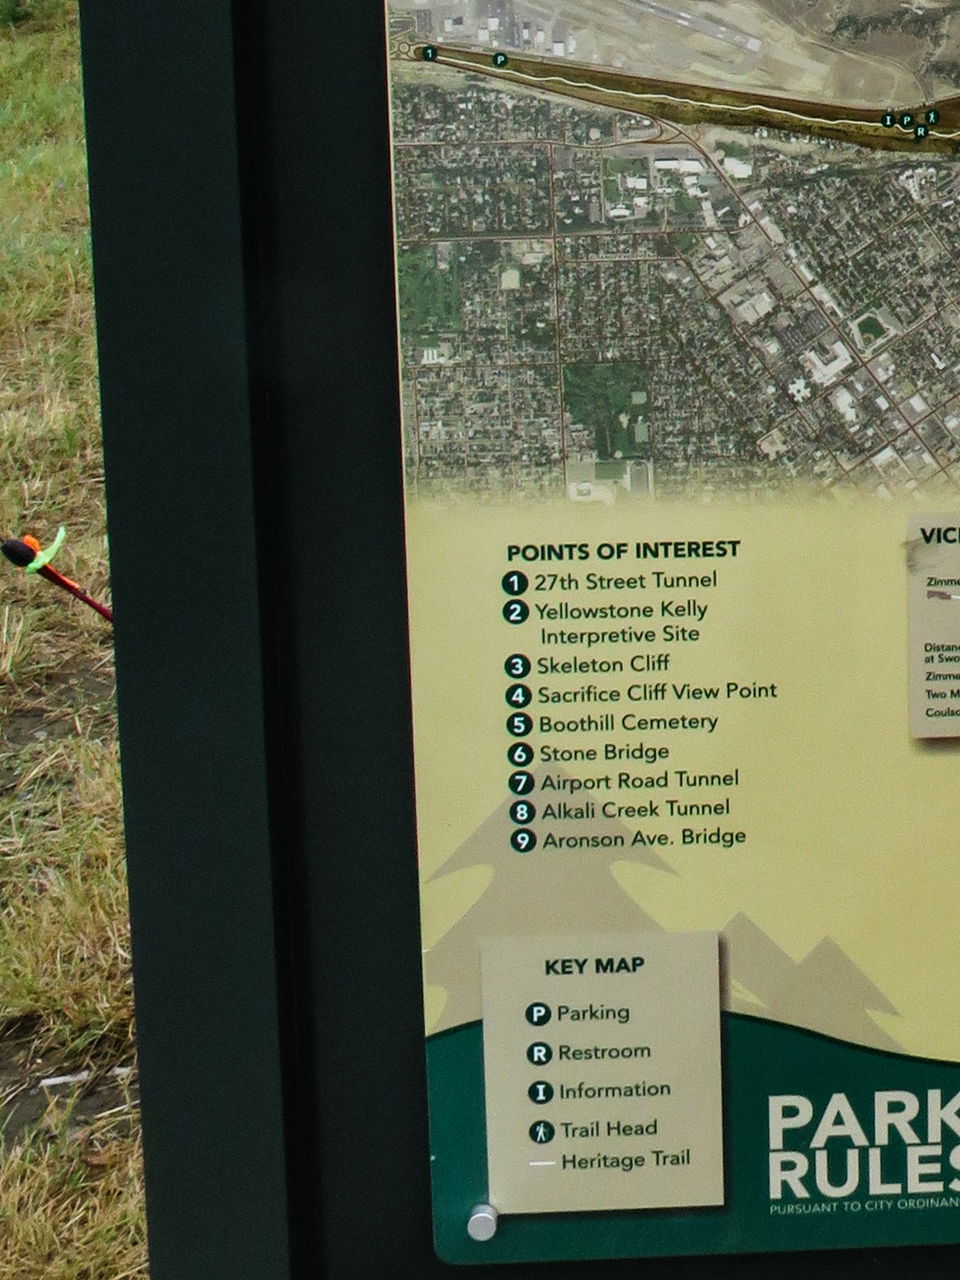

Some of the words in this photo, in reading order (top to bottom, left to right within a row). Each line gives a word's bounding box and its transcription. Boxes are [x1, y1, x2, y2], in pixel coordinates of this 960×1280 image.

[508, 544, 589, 561] POINTS
[597, 543, 628, 559] OF
[636, 541, 740, 558] INTEREST
[535, 574, 579, 591] 27th
[586, 573, 646, 590] Street
[652, 571, 717, 587] Tunnel
[536, 603, 653, 620] Yellowstone
[661, 600, 708, 621] Kelly
[542, 628, 656, 648] Interpretive
[663, 626, 699, 642] Site
[538, 657, 623, 674] Skeleton
[631, 654, 670, 671] Cliff
[538, 686, 620, 703] Sacrifice
[628, 684, 668, 701] Cliff
[672, 683, 719, 699] View
[727, 682, 777, 699] Point
[925, 690, 946, 699] Two
[540, 715, 614, 733] Boothill
[622, 715, 718, 733] Cemetery
[541, 745, 597, 762] Stone
[605, 743, 669, 763] Bridge
[541, 775, 611, 794] Airport
[619, 772, 668, 788] Road
[675, 769, 738, 787] Tunnel
[542, 803, 594, 819] Alkali
[602, 800, 659, 817] Creek
[666, 799, 730, 815] Tunnel
[543, 832, 624, 849] Aronson
[632, 831, 673, 846] Ave.
[682, 828, 746, 847] Bridge
[546, 959, 588, 975] KEY
[596, 957, 644, 973] MAP
[558, 1005, 630, 1022] Parking
[559, 1044, 651, 1060] Restroom
[560, 1081, 671, 1098] Information
[561, 1122, 599, 1138] Trail
[608, 1119, 657, 1136] Head
[562, 1152, 644, 1171] Heritage
[652, 1150, 690, 1166] Trail
[770, 1202, 839, 1215] PURSUANT
[843, 1201, 861, 1212] TO
[865, 1200, 893, 1211] CITY
